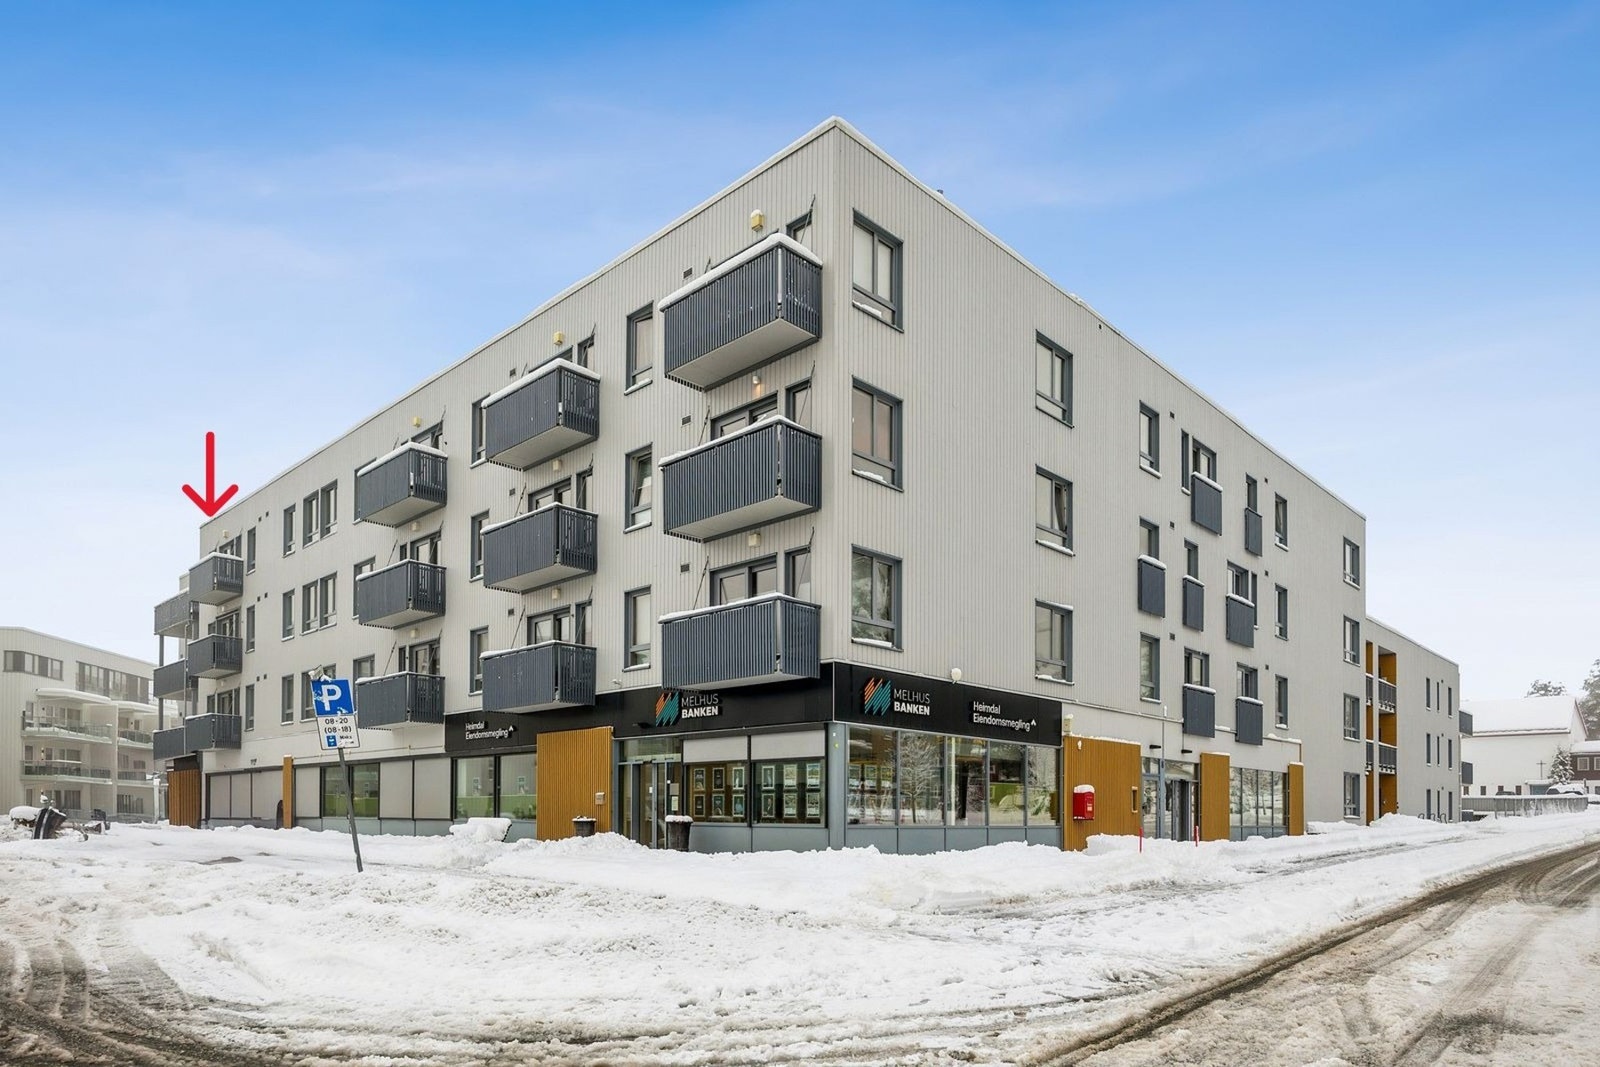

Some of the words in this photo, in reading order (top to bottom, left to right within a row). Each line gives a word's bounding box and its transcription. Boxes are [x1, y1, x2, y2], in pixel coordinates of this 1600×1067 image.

[321, 684, 342, 711] P
[681, 693, 719, 707] MELHUS
[894, 688, 930, 704] MELHUS
[681, 706, 718, 719] BANKEN
[894, 701, 930, 716] BANKEN
[973, 701, 1001, 714] Heimdal
[465, 721, 485, 731] Heimdal
[973, 713, 1030, 732] Eiendomsmegling
[466, 728, 508, 740] Eiendomsmegling
